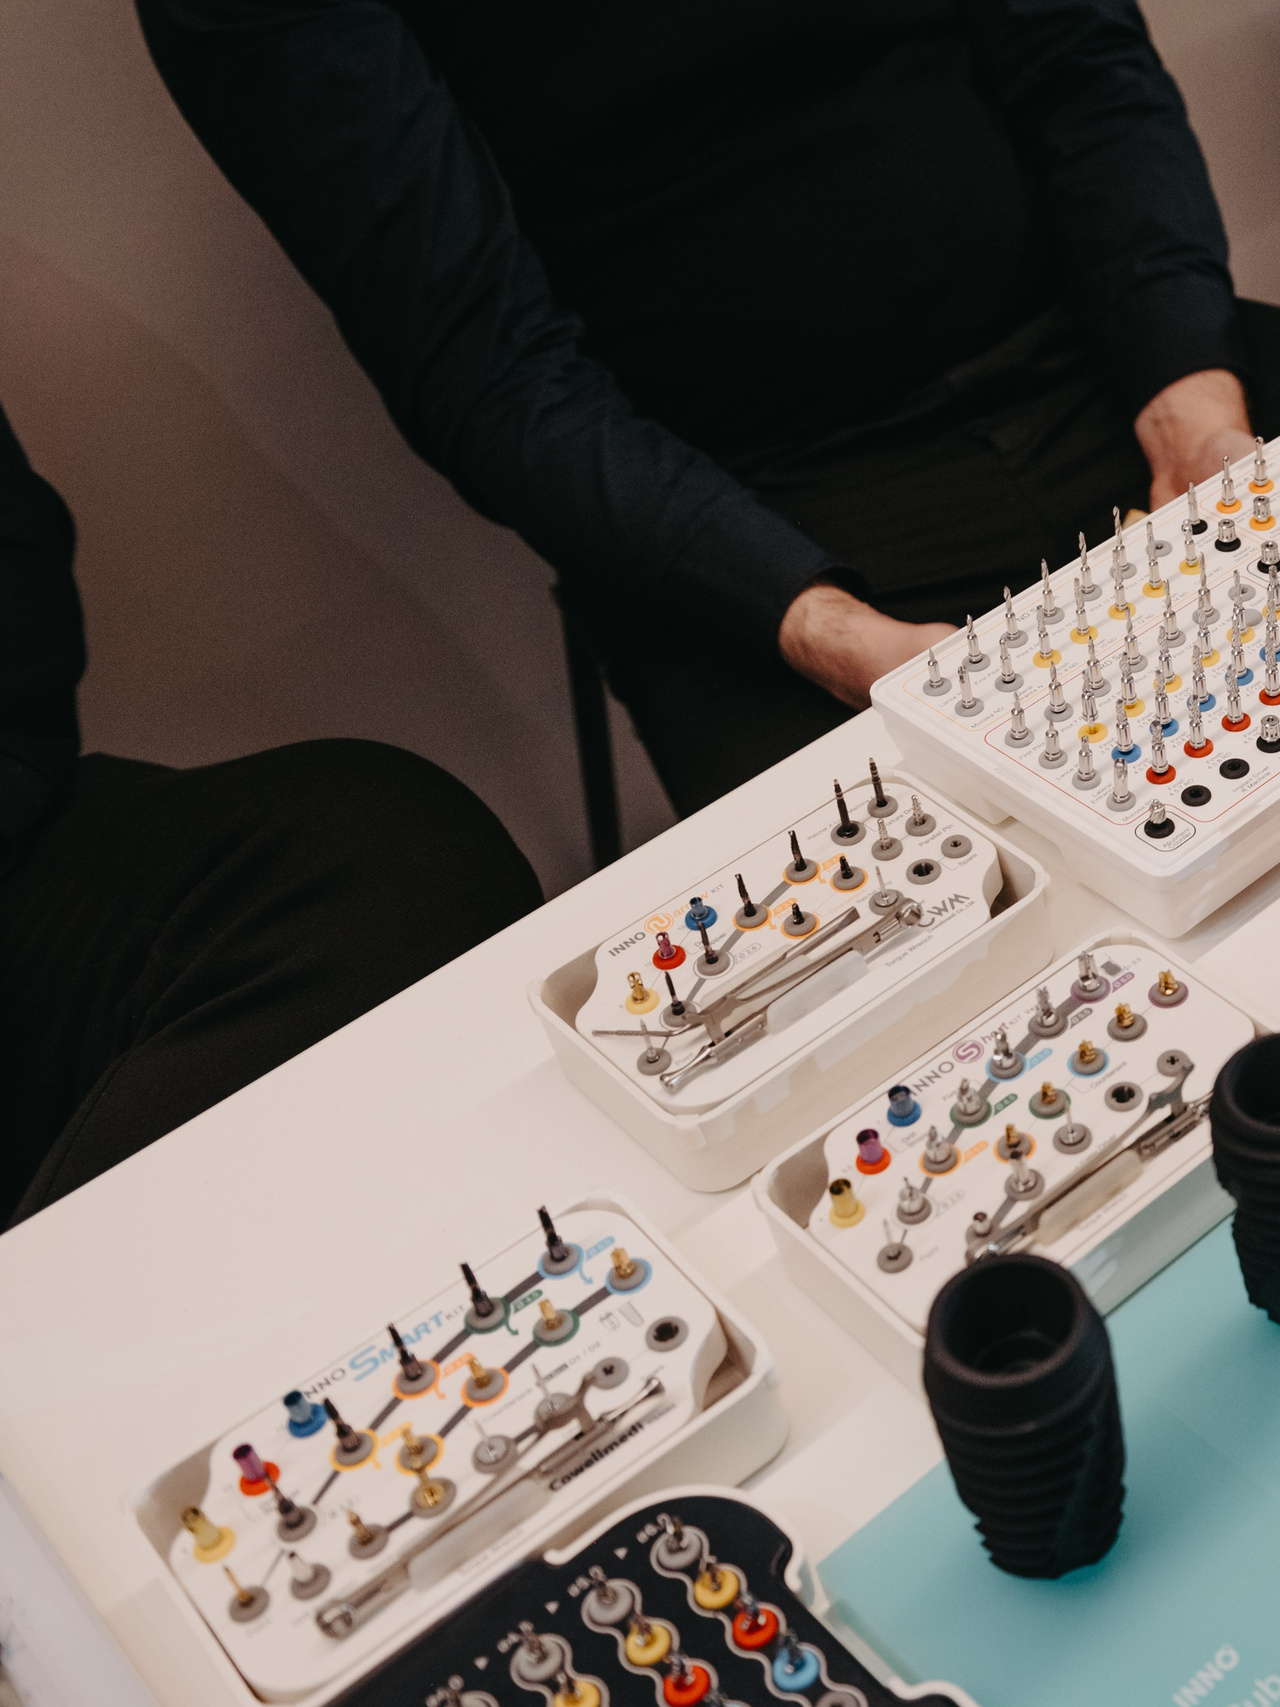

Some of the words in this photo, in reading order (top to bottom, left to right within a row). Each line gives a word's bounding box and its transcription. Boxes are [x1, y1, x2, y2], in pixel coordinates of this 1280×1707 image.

[969, 712, 995, 729] Mucosa
[918, 830, 940, 848] Parallel
[941, 824, 954, 834] Pin
[957, 853, 979, 868] Spare
[609, 931, 646, 957] INNO
[710, 883, 725, 895] KIT
[918, 894, 970, 927] CWM
[885, 951, 908, 967] Torque
[909, 934, 934, 952] Wrench
[910, 1061, 954, 1096] INNO
[1008, 1014, 1023, 1026] KIT
[304, 1368, 346, 1399] NNO
[444, 1304, 465, 1321] KIT
[550, 1421, 644, 1491] Cowellmedi
[1172, 1643, 1241, 1707] INNO
